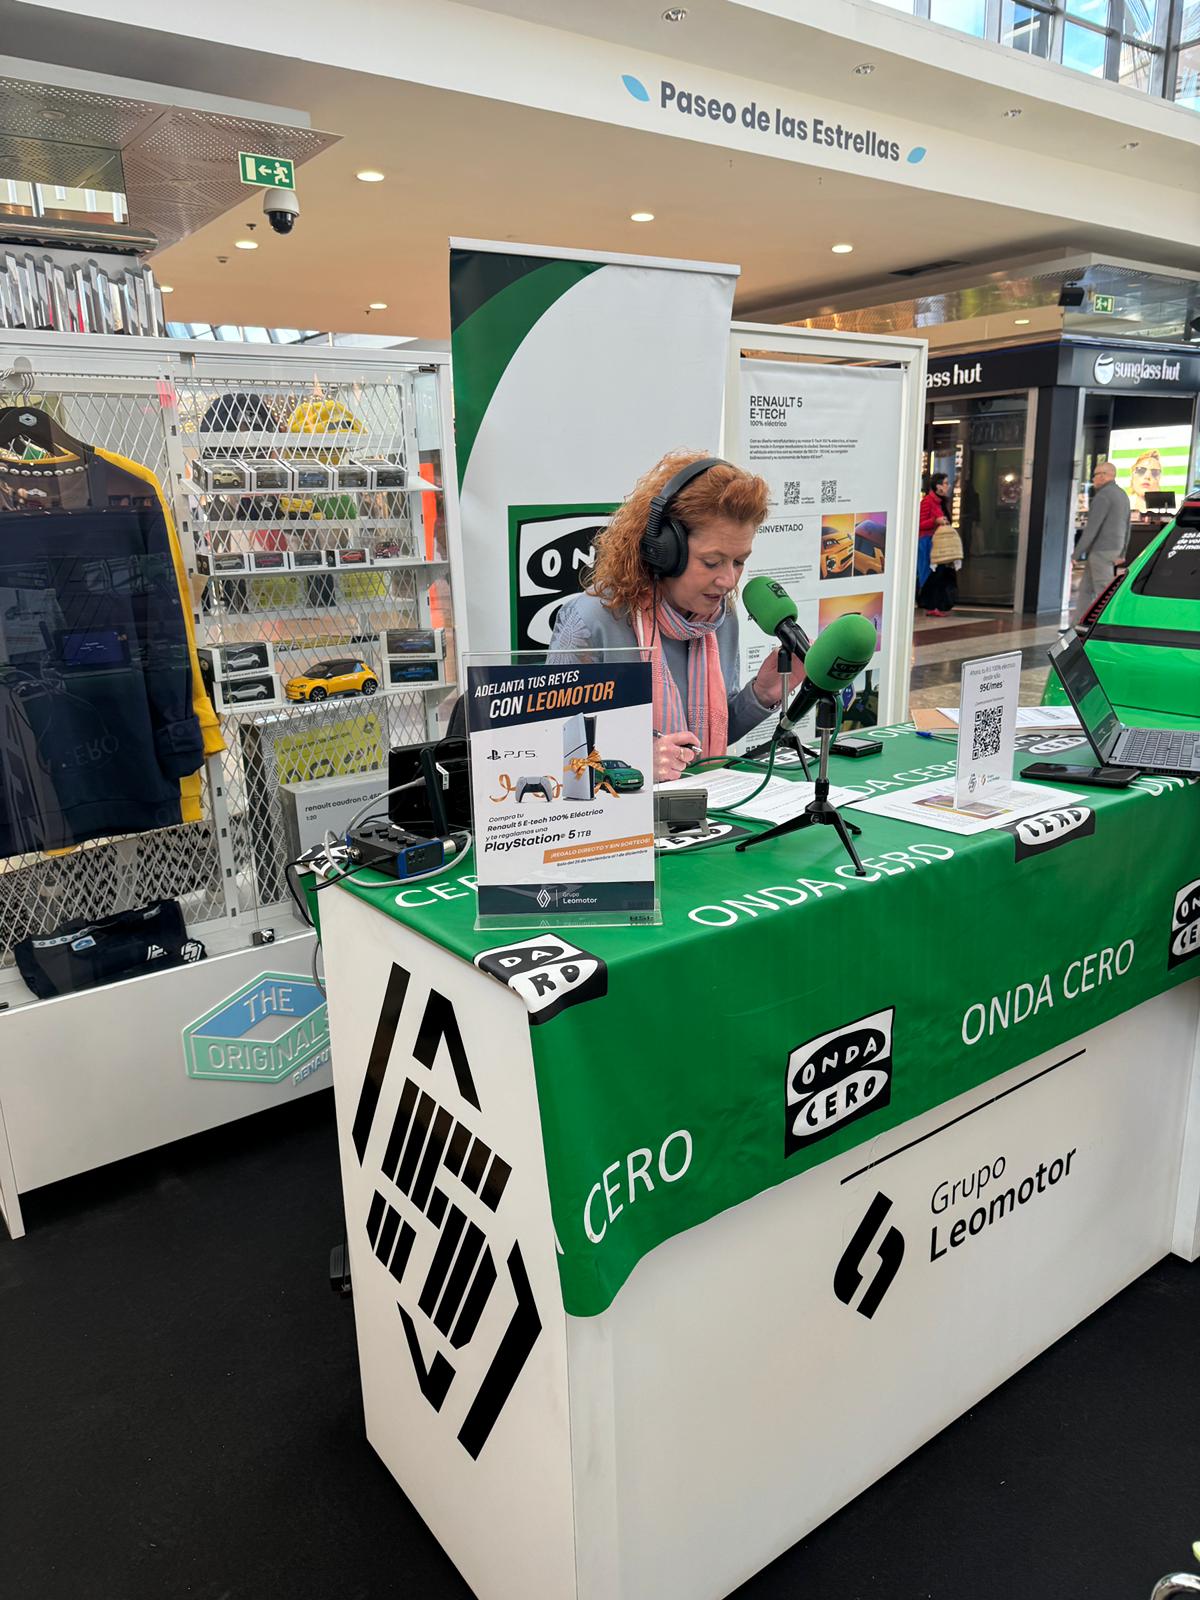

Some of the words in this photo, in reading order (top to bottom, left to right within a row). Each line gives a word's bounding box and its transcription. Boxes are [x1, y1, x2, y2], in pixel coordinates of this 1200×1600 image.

[660, 80, 737, 124] Paseo
[741, 102, 771, 132] de
[775, 108, 808, 141] las
[812, 119, 900, 162] Estrellas
[953, 363, 982, 385] hut
[1115, 357, 1161, 384] sunglass
[1162, 359, 1180, 381] hut
[750, 395, 796, 408] RENAULT
[797, 397, 803, 408] 5
[750, 408, 786, 420] E-TECH
[541, 545, 596, 578] ON
[474, 679, 525, 698] ADELANTA
[527, 676, 546, 690] TUS
[548, 670, 580, 687] REYES
[489, 695, 524, 718] CON
[527, 681, 615, 713] LEOMOTOR
[305, 802, 332, 812] renault
[487, 823, 517, 832] Renault
[523, 818, 548, 827] E-tech
[548, 814, 569, 822] 100%
[569, 809, 604, 819] Eléctrico
[488, 814, 516, 823] Compra
[498, 829, 534, 840] regalamos
[568, 829, 576, 839] 5
[577, 830, 592, 838] 1TB
[687, 876, 847, 927] ONDA
[834, 843, 955, 882] CERO
[1181, 897, 1200, 918] ON
[1180, 924, 1198, 949] CE
[243, 986, 295, 1023] THE
[961, 974, 1054, 1046] ONDA
[1063, 938, 1135, 1000] CERO
[801, 1036, 878, 1085] ONDA
[805, 1076, 877, 1127] CERO
[583, 1129, 693, 1244] CERO
[930, 1156, 1006, 1215] Grupo
[929, 1148, 1077, 1263] Leomotor
